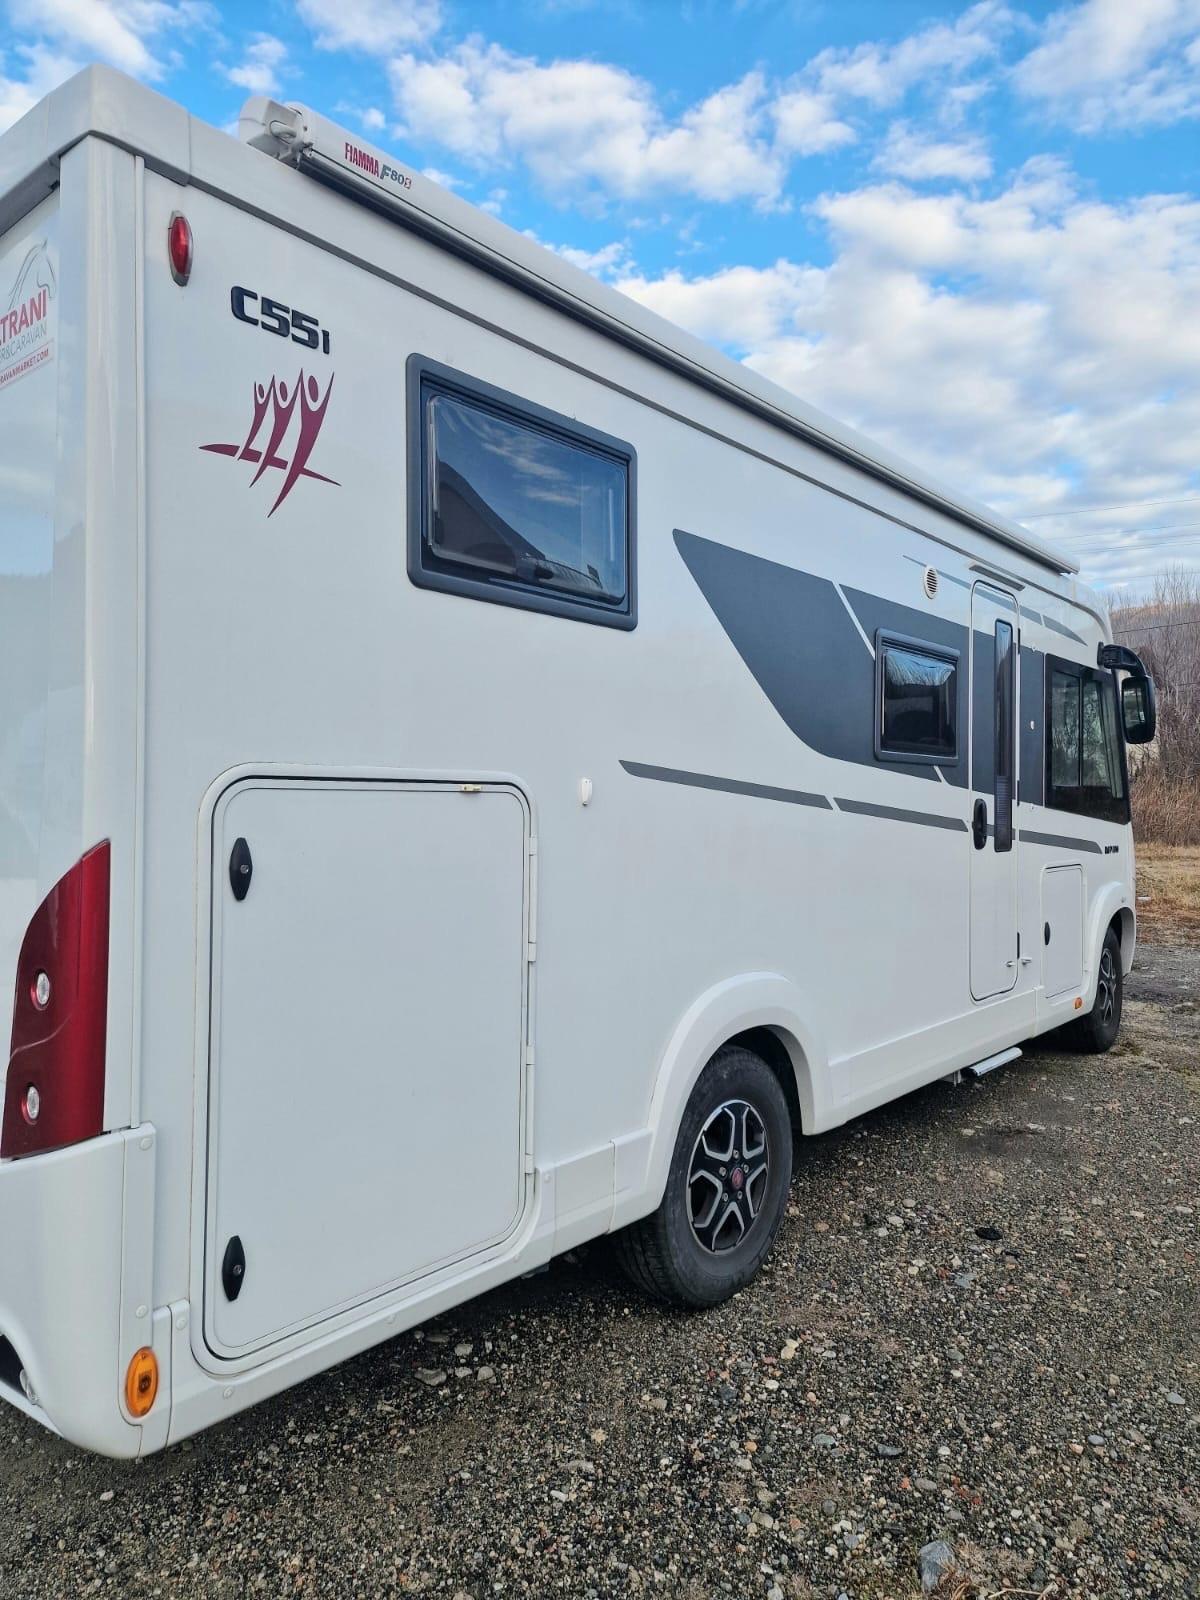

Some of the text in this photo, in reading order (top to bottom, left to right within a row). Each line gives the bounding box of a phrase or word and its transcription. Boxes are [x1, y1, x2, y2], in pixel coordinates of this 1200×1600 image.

[345, 142, 379, 177] FIAMMA
[0, 289, 47, 346] TRANI
[0, 322, 48, 361] R&CARAVAN
